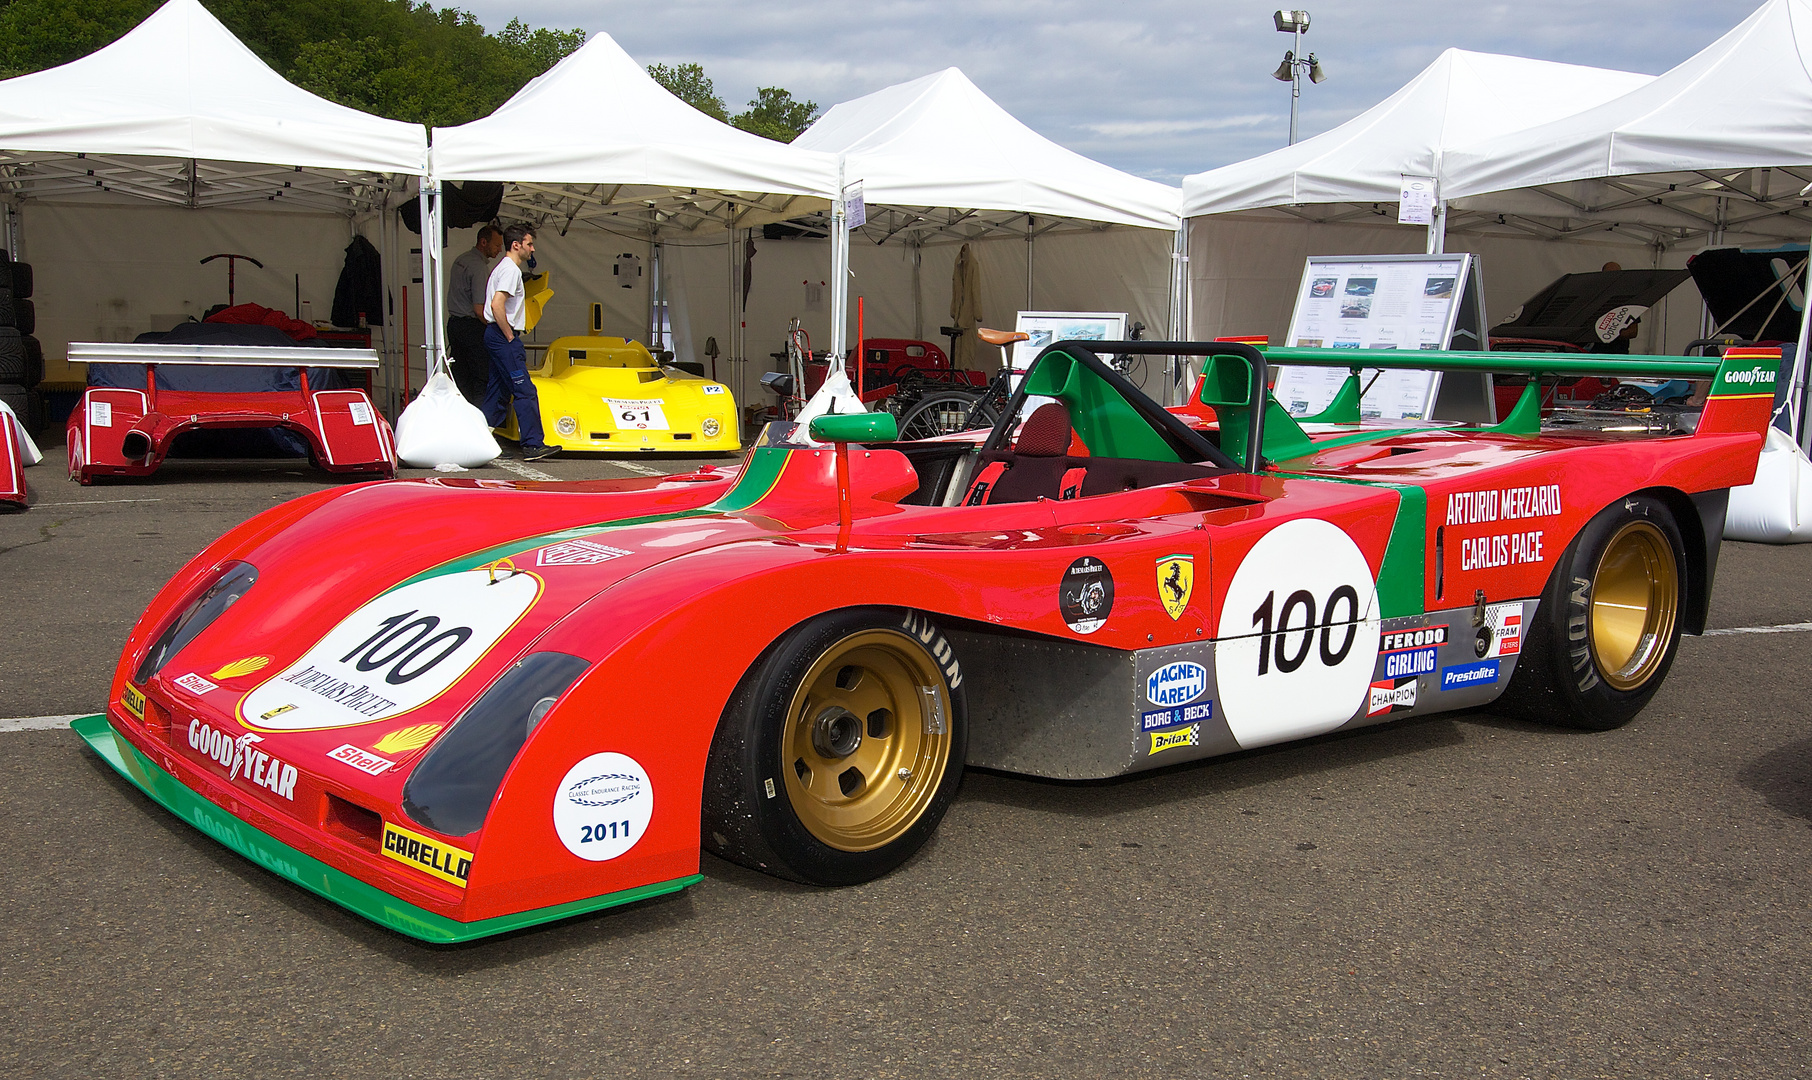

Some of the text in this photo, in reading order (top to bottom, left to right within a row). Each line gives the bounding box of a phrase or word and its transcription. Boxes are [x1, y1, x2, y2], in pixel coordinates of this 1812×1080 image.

[1602, 307, 1628, 340] Optic 2000
[1725, 370, 1776, 384] GOODYEAR
[621, 411, 650, 421] 61
[1446, 484, 1561, 526] ARTURIO MERZARIO
[545, 542, 612, 563] HEUER
[1462, 530, 1543, 571] CARLOS PACE
[1252, 585, 1358, 676] 100
[1384, 628, 1445, 650] FERODO
[1496, 628, 1518, 638] FRAM
[1569, 576, 1600, 693] AVON
[339, 609, 472, 685] 100
[902, 608, 963, 691] AVON
[1501, 640, 1519, 650] FILTERS
[1387, 650, 1435, 676] GIRLING
[180, 675, 213, 692] Shell
[1149, 664, 1205, 692] MAGNETI
[1445, 667, 1495, 685] Prestolite
[281, 665, 397, 716] AUDEMARS PIGUET
[1149, 675, 1205, 704] MARELLI
[1371, 687, 1415, 707] CHAMPION
[1144, 704, 1210, 729] BORG & BECK
[1155, 733, 1189, 748] Britax
[188, 718, 298, 801] GOODYEAR
[335, 747, 388, 772] Shell
[580, 820, 629, 843] 2011
[384, 829, 472, 880] CARELLO
